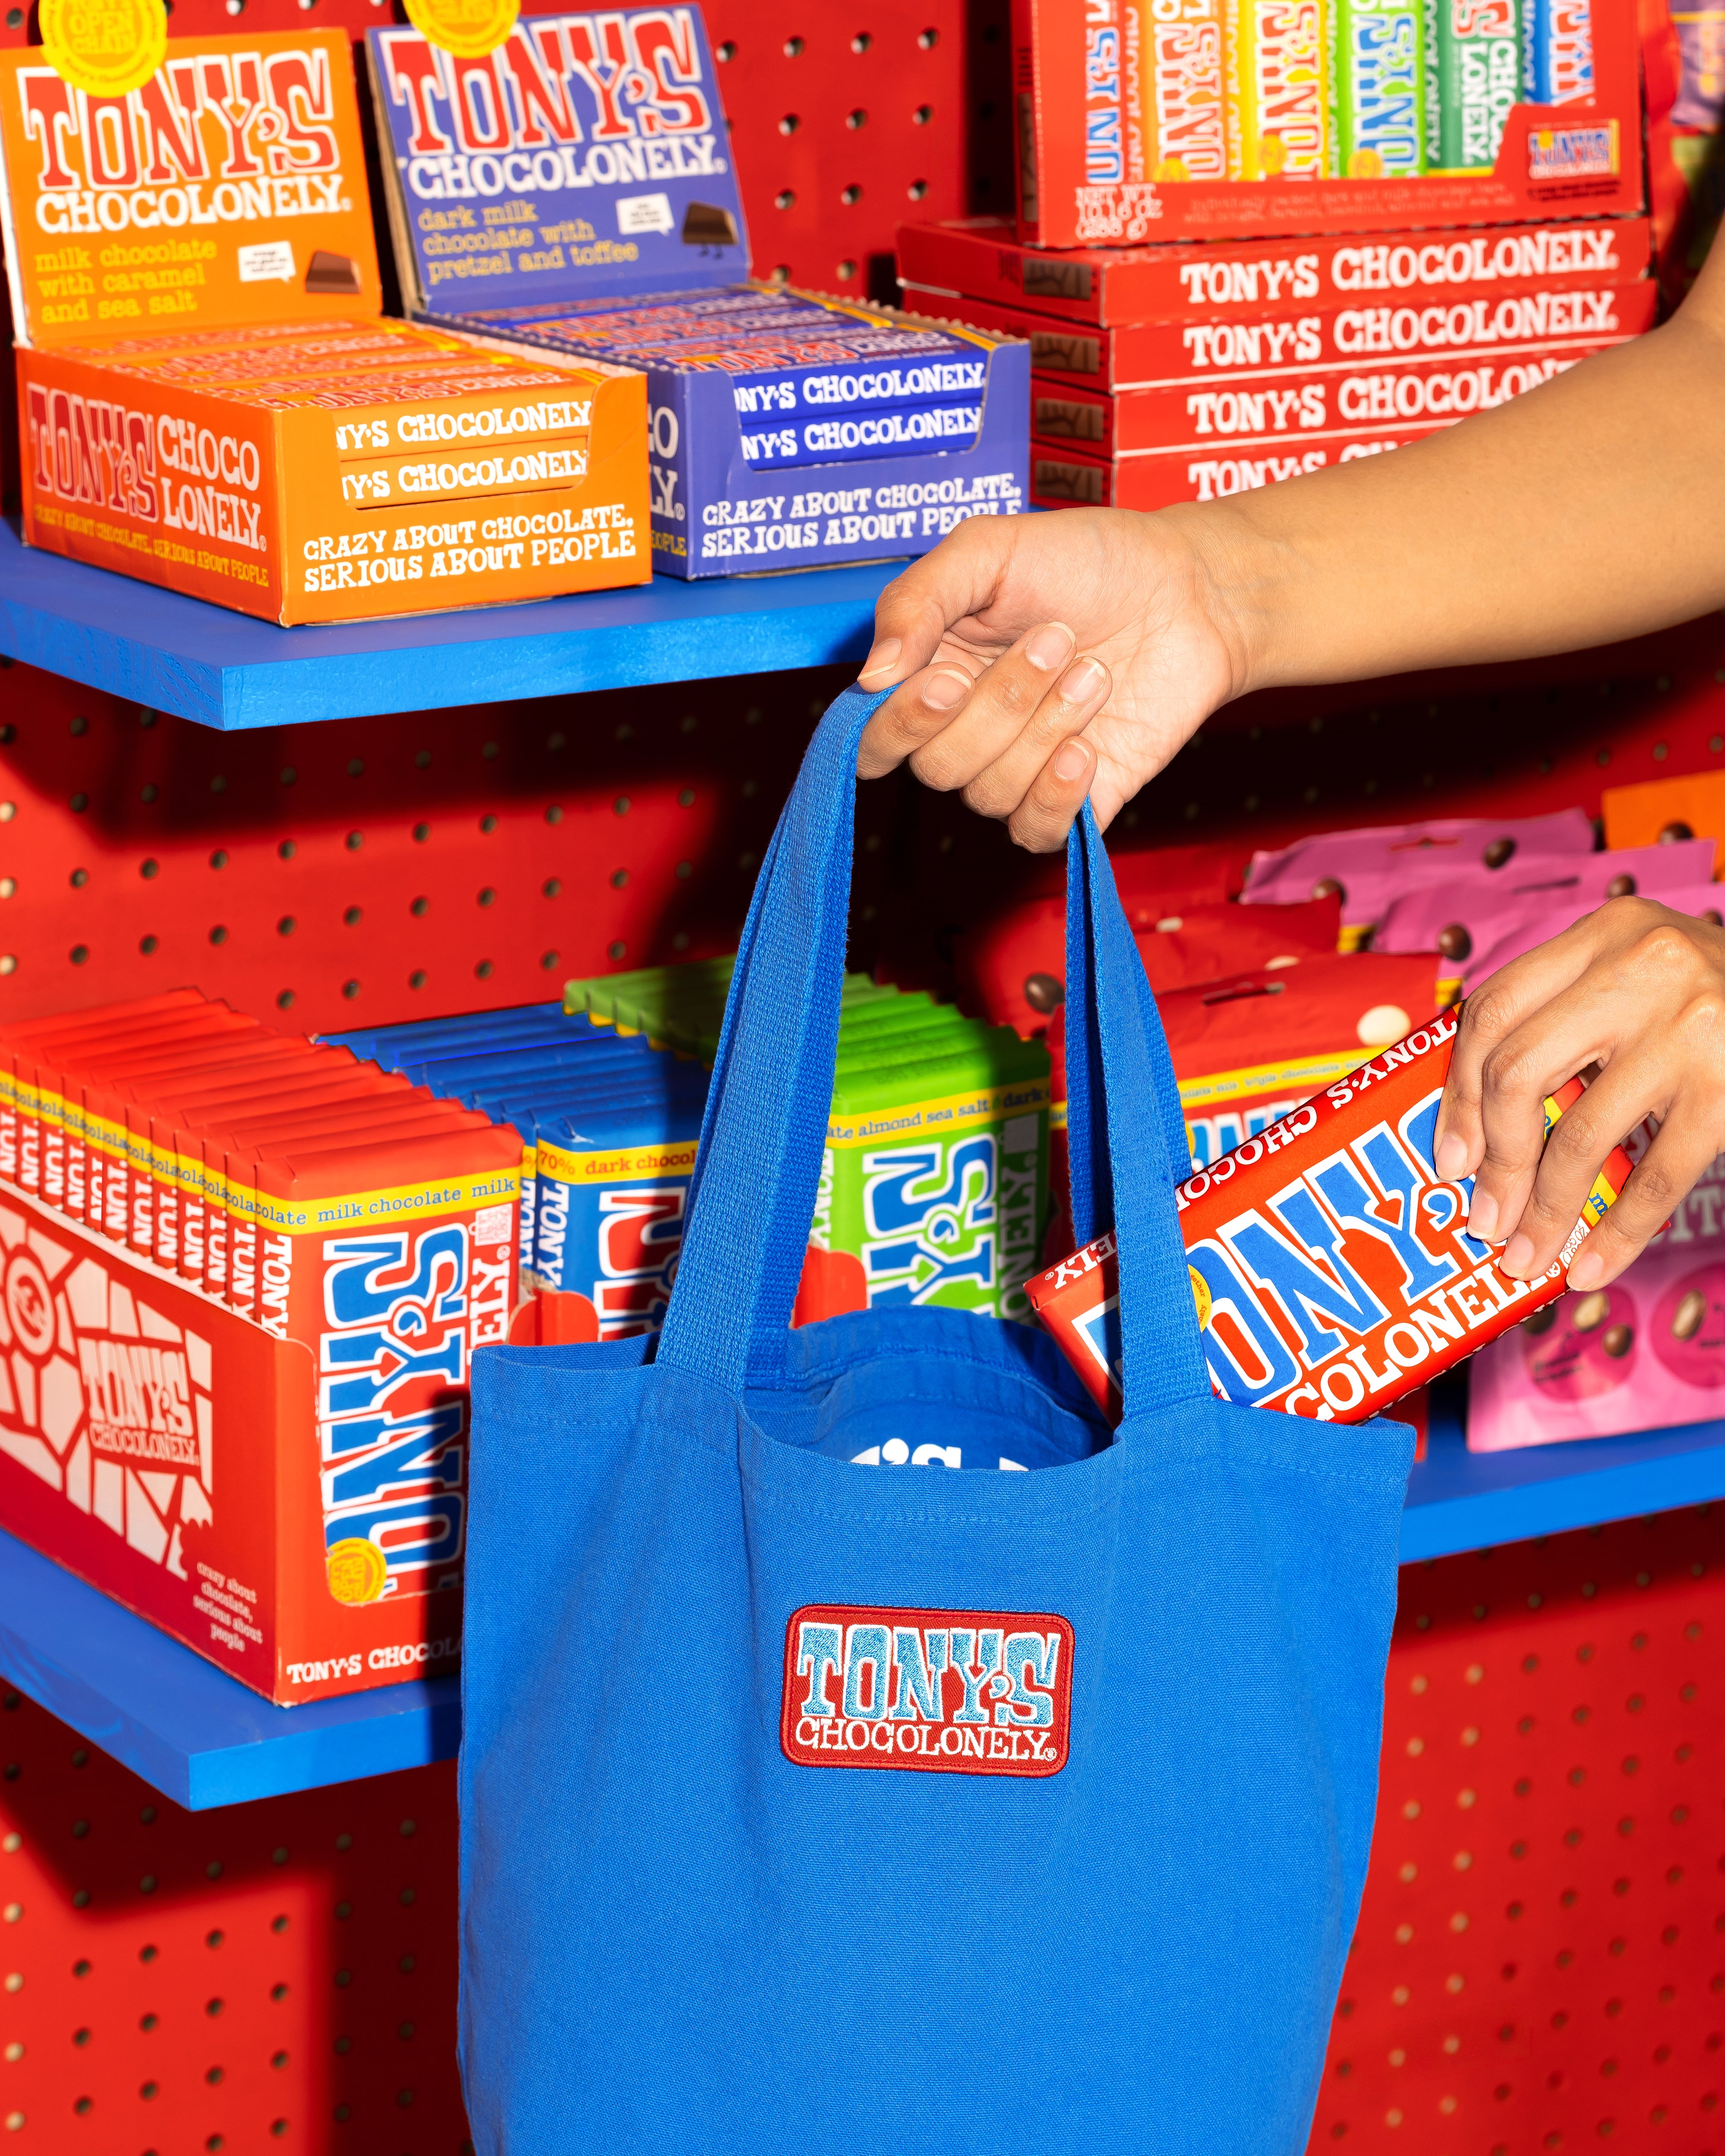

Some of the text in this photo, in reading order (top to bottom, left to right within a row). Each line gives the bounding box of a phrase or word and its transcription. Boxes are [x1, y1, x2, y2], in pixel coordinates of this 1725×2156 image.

[379, 8, 713, 156] TONY'S
[16, 48, 341, 191] TONY'S
[418, 199, 539, 232] dark milk
[422, 219, 597, 256] chocolate with
[34, 246, 92, 273] milk
[99, 237, 217, 267] chocolate
[426, 241, 640, 286] pretzel and toffee
[37, 261, 207, 298] with caramel
[1180, 255, 1320, 304] TONY'S
[41, 289, 198, 324] and sea salt
[1183, 317, 1322, 368] TONY'S
[397, 400, 592, 443] CHOCOLONELY
[1187, 384, 1326, 435] TONY'S
[26, 382, 159, 523] TONY'S
[157, 415, 261, 491] CHOCO
[398, 450, 589, 493] CHOCOLONELY
[702, 473, 1022, 527] CRAZY ABOUT CHOCOLATE,
[303, 504, 634, 562] CRAZY ABOUT CHOCOLATE,
[701, 522, 818, 559] SERIOUS
[823, 513, 918, 546] ABOUT
[232, 557, 269, 588] PEOPLE
[304, 530, 636, 593] SERIOUS ABOUT PEOPLE
[1327, 1017, 1459, 1109] TONY'S
[858, 1111, 922, 1138] almond
[926, 1107, 953, 1123] sea
[958, 1097, 989, 1117] salt
[1003, 1090, 1043, 1108] dark
[539, 1150, 575, 1175] 70%
[585, 1157, 631, 1176] dark
[317, 1203, 364, 1223] milk
[368, 1188, 462, 1215] chocolate
[471, 1178, 516, 1199] milk
[79, 1337, 194, 1437] TONY'S
[320, 1222, 468, 1600] ONY'S
[197, 1562, 258, 1604] crazy about
[193, 1594, 264, 1644] serious about
[210, 1622, 245, 1653] people
[286, 1653, 362, 1684] TONY'S
[796, 1622, 1062, 1728] TONY'S
